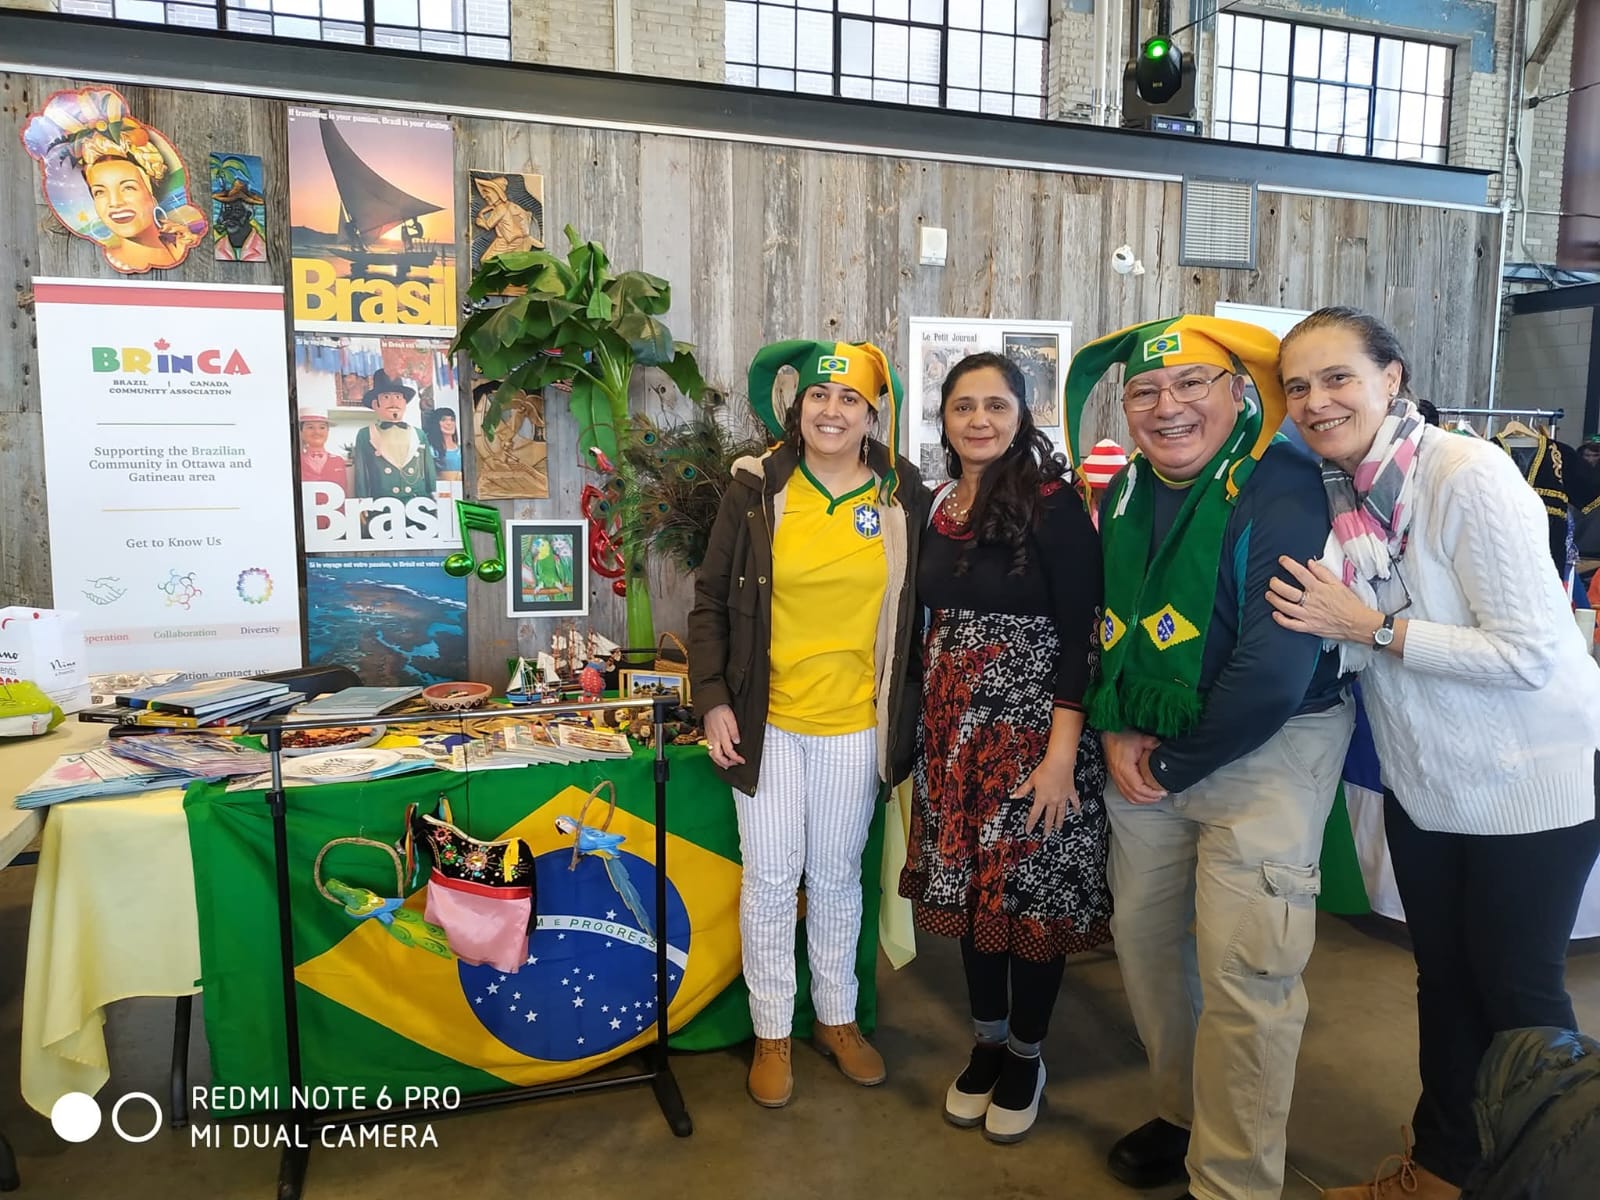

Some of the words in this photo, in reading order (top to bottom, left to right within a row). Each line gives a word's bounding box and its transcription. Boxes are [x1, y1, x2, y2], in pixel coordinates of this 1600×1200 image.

[291, 257, 457, 326] Brasil
[922, 332, 930, 341] Le
[934, 332, 948, 341] Petit
[952, 332, 977, 342] Journal
[190, 380, 229, 388] CANADA
[109, 387, 167, 396] COMMUNITY
[170, 388, 232, 396] ASSOCIATION
[94, 446, 165, 459] Supporting
[168, 446, 188, 456] the
[191, 446, 246, 456] Brazilian
[89, 458, 162, 471] Community
[166, 459, 178, 469] in
[181, 459, 226, 469] Ottawa
[229, 458, 252, 469] and
[128, 471, 185, 482] Gatineau
[189, 474, 216, 482] area
[301, 480, 463, 541] Brasil
[126, 538, 148, 549] Get
[152, 538, 164, 548] to
[168, 537, 202, 548] Know
[206, 536, 222, 546] Us
[153, 628, 217, 640] Collaboration
[240, 624, 280, 636] Diversity
[215, 668, 251, 678] contact
[554, 918, 561, 926] E
[569, 918, 658, 949] PROGRESS
